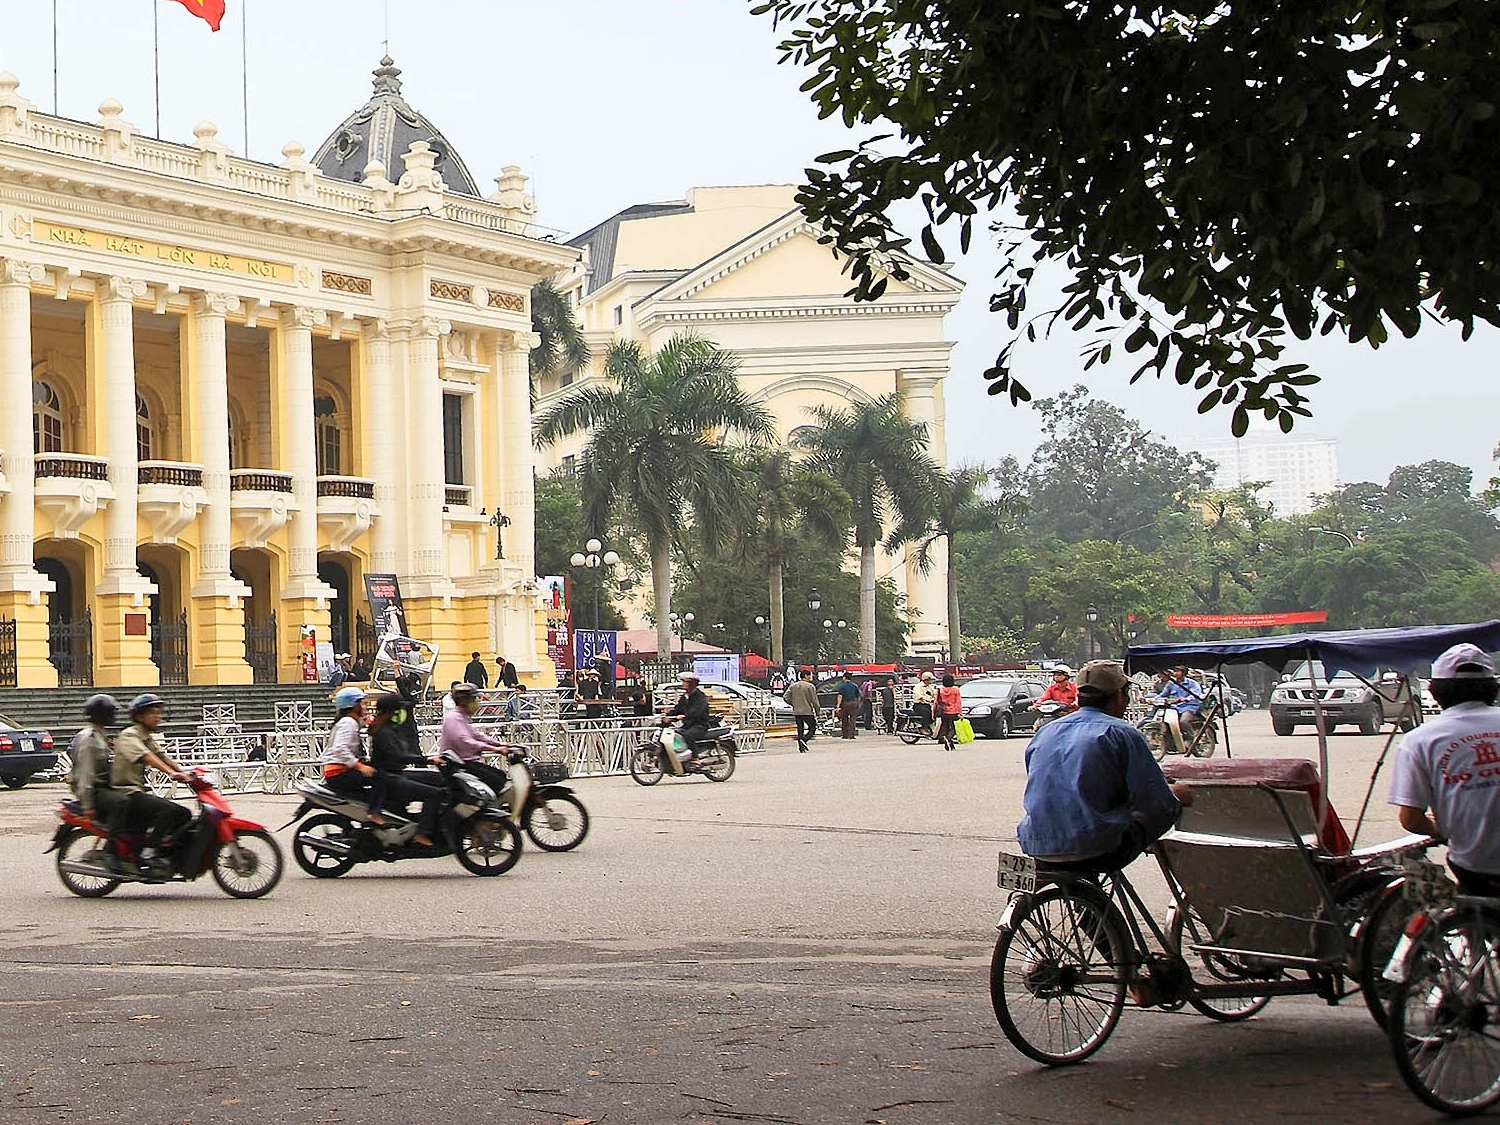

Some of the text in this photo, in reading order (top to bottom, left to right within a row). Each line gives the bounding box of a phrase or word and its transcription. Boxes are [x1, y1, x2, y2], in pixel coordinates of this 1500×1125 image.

[49, 228, 277, 279] NHÀ HÁT LỚN HÀ NỘI
[1013, 857, 1026, 872] 29
[1001, 872, 1034, 892] E-360
